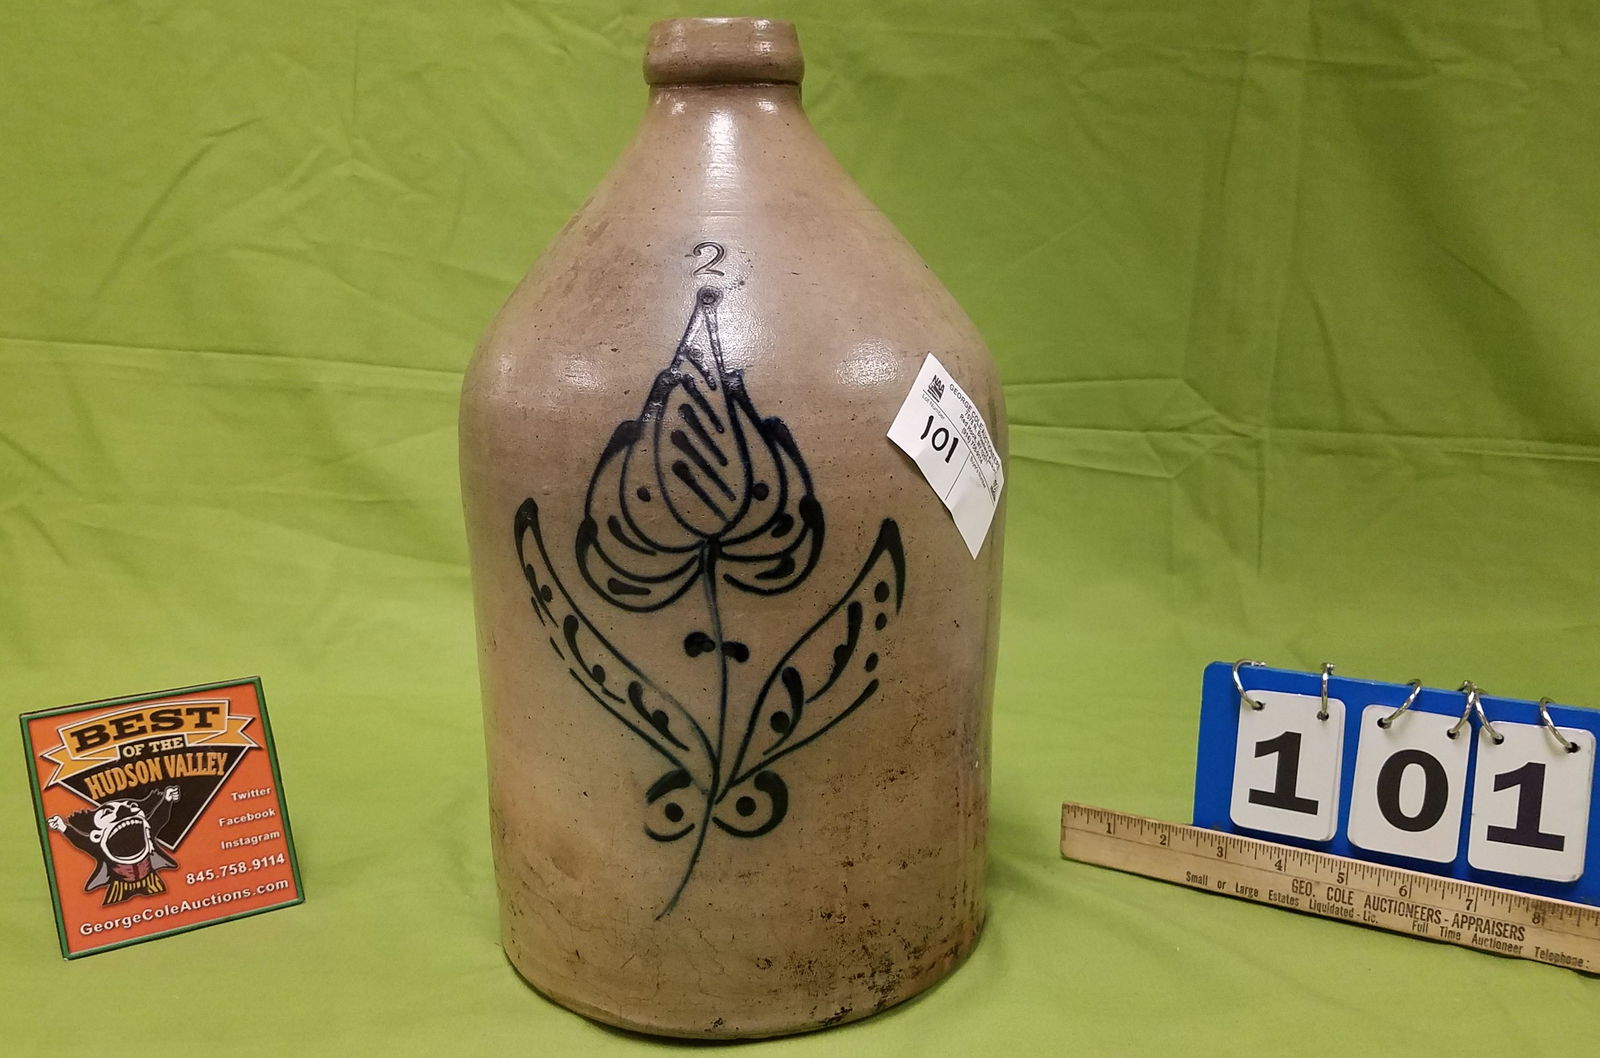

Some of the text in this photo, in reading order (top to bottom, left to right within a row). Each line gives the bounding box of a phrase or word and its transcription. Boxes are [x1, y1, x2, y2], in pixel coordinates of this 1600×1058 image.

[692, 241, 725, 277] 2
[933, 375, 945, 393] NAA
[949, 384, 972, 412] GEORGE
[972, 411, 983, 430] COLE
[920, 415, 960, 464] 101
[70, 707, 220, 753] BEST
[122, 736, 185, 759] OF THE
[84, 752, 229, 801] HUDSON VALLEY
[231, 786, 272, 802] Twitter
[218, 807, 277, 828] Facebook
[219, 830, 281, 851] Instagram
[185, 853, 286, 885] 845.758.9114
[1106, 822, 1541, 926] 1 2 3 4 5 6 7 8
[79, 877, 290, 937] GeorgeColeAuctions.com
[1185, 870, 1209, 886] Small
[1217, 880, 1227, 891] or
[1235, 882, 1259, 899] Large
[1268, 888, 1300, 908] Estates
[1308, 899, 1355, 920] Liquidated
[1291, 878, 1316, 898] GEO.
[1326, 886, 1355, 906] COLE
[1363, 894, 1443, 926] AUCTIONEERS
[1451, 912, 1526, 943] APPRAISERS
[1411, 919, 1430, 935] Full
[1439, 925, 1462, 942] Time
[1471, 931, 1524, 956] Auctioneer
